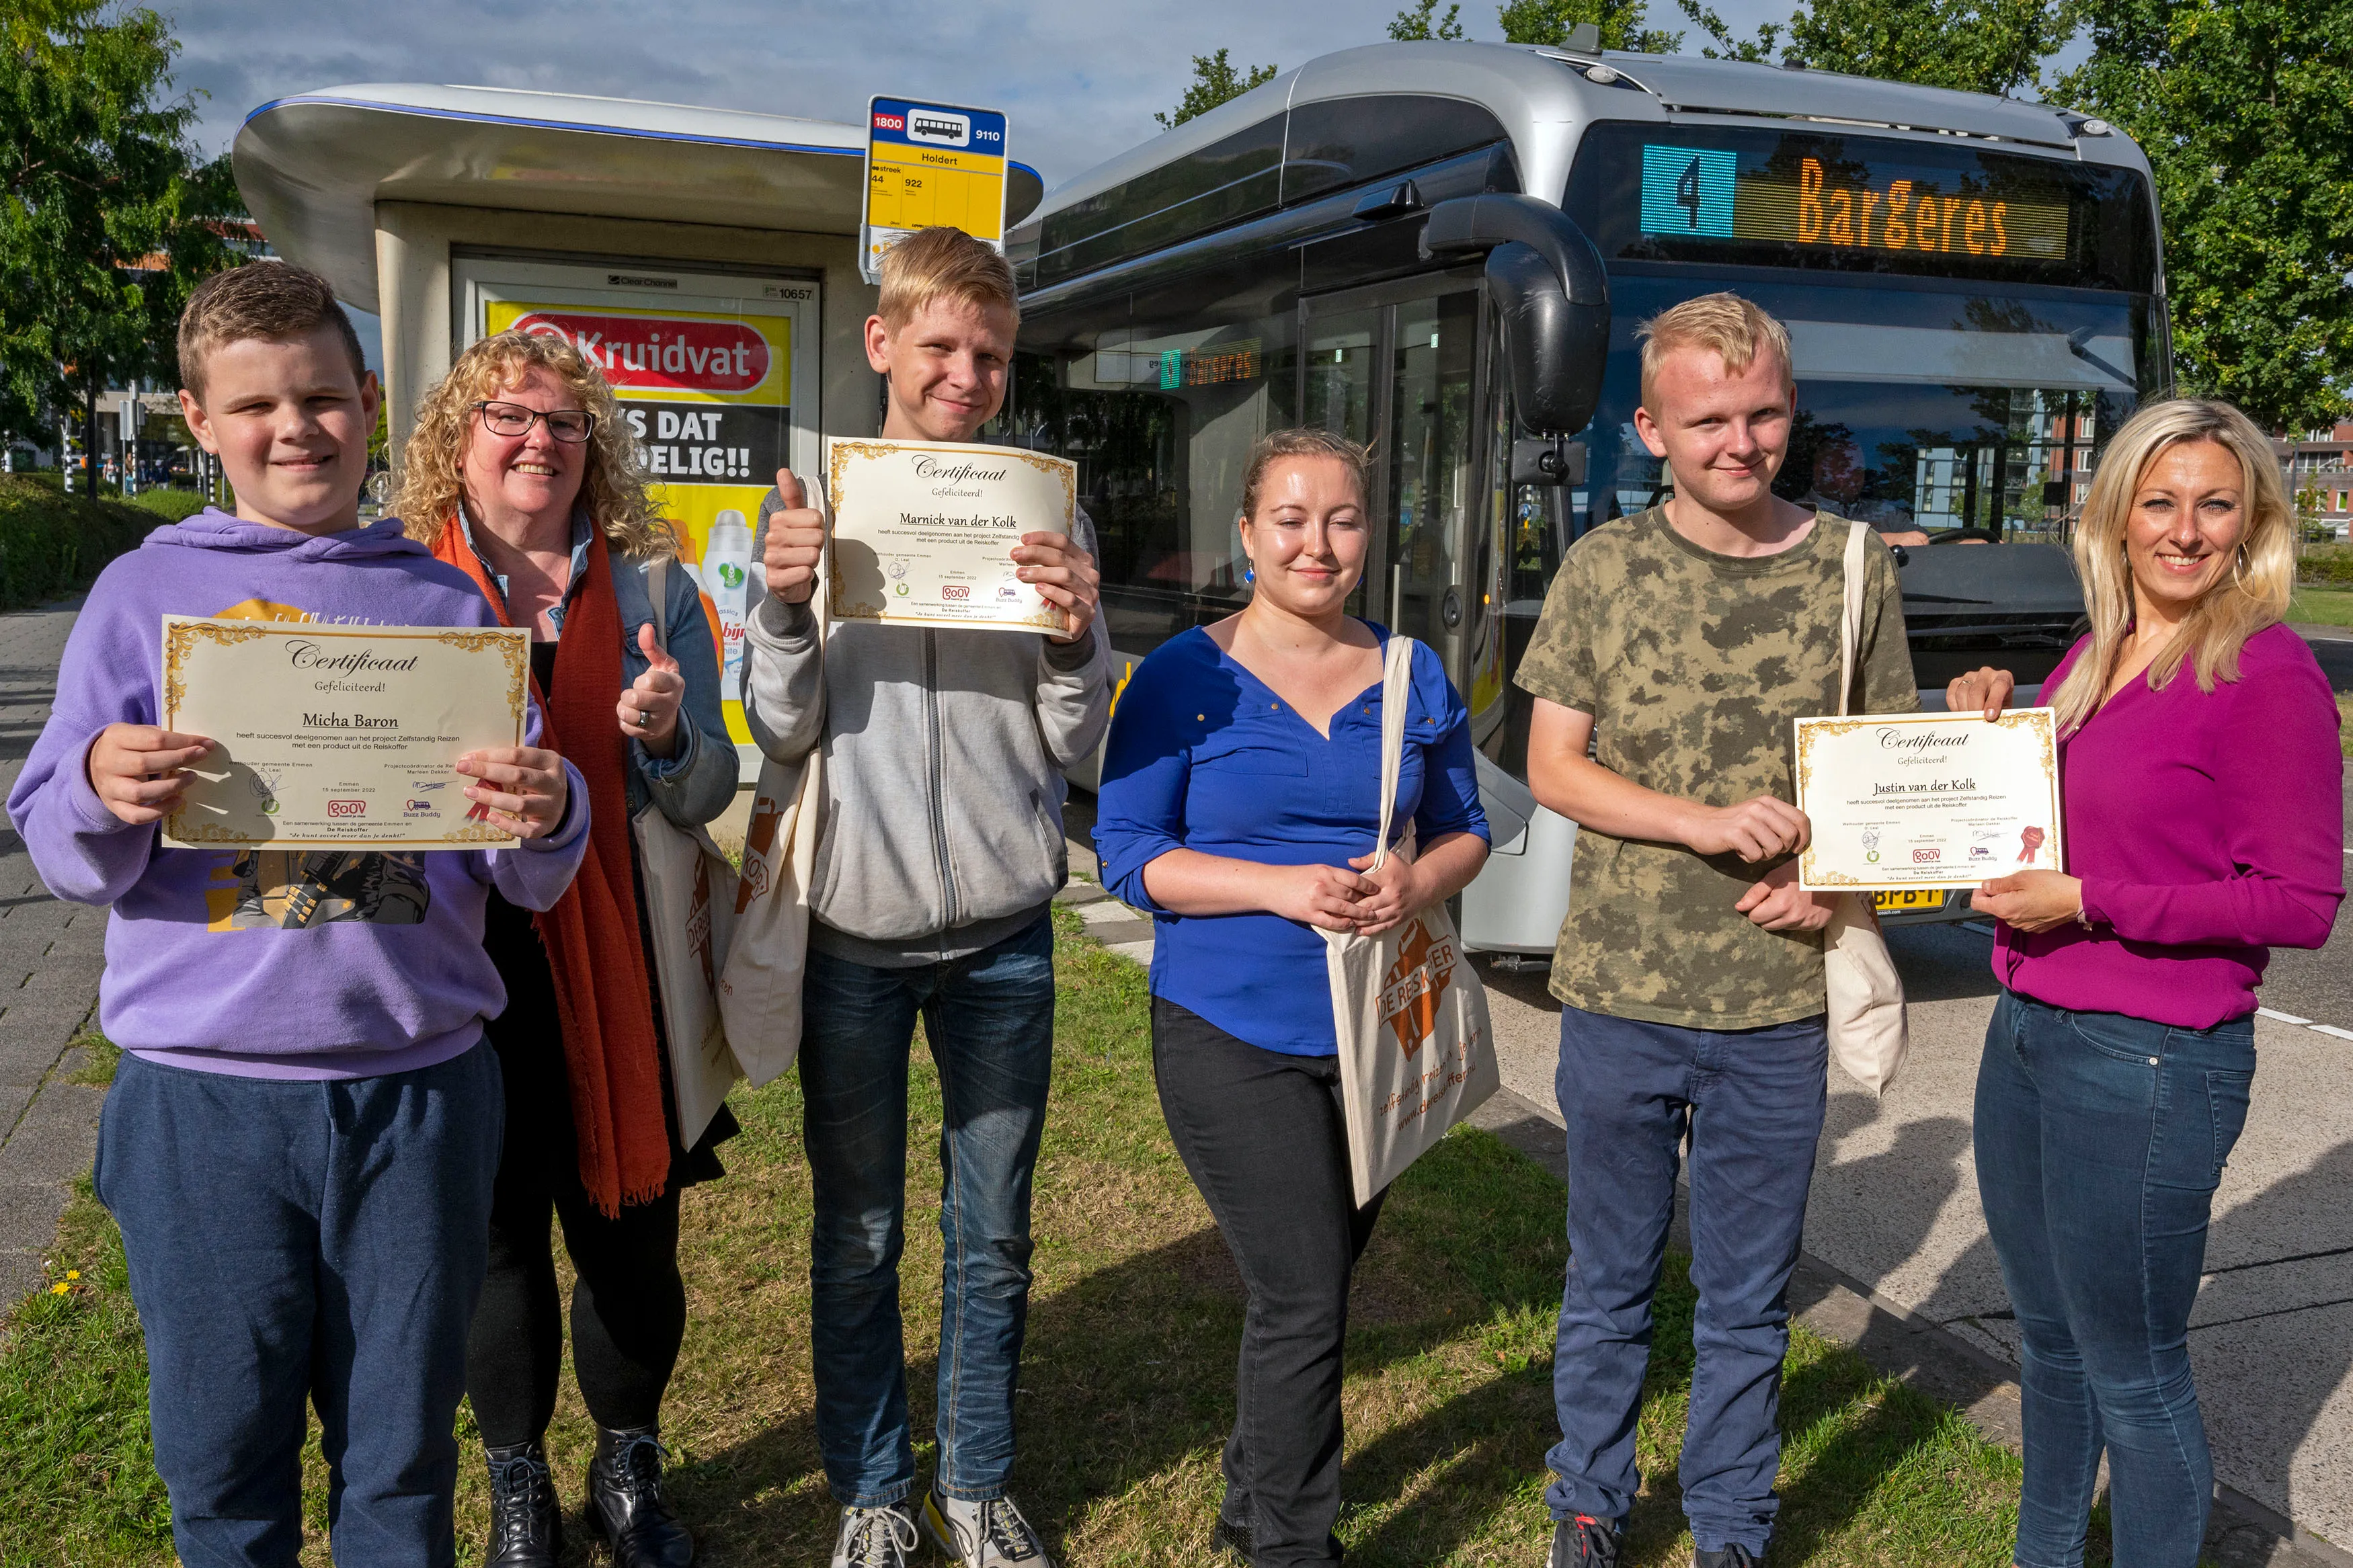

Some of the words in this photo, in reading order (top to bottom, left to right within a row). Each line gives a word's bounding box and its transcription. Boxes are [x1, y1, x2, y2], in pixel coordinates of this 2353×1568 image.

[875, 117, 902, 129] 1800
[976, 130, 1000, 141] 9110
[922, 153, 957, 165] Holdert
[905, 179, 922, 188] 922
[1675, 155, 1700, 231] 4
[1798, 157, 2007, 257] Bargeres
[621, 277, 642, 286] Clear
[643, 279, 677, 289] Channel
[779, 289, 811, 299] 10657
[577, 331, 750, 376] Kruidvat
[658, 411, 722, 441] DAT
[912, 454, 1007, 486] Certificaat
[932, 487, 983, 499] Gefeliciteerd!
[900, 513, 945, 526] Marnick
[948, 517, 967, 526] van
[971, 515, 989, 527] der
[991, 516, 1016, 528] Kolk
[285, 639, 419, 678] Certificaat
[315, 680, 385, 694] Gefeliciteerd!
[303, 712, 350, 727] Micha
[354, 713, 399, 728] Baron
[294, 734, 343, 743] deelgenomen
[372, 735, 397, 743] project
[398, 735, 435, 743] Zelfstandig
[1876, 727, 1969, 754] Certificaat
[323, 743, 350, 751] product
[1897, 755, 1948, 766] Gefeliciteerd!
[1873, 782, 1905, 796] Justin
[1909, 783, 1929, 792] van
[1931, 780, 1949, 792] der
[1952, 778, 1977, 790] Kolk
[1940, 796, 1958, 804] project
[1380, 993, 1394, 1020] DE
[1458, 1042, 1467, 1061] je
